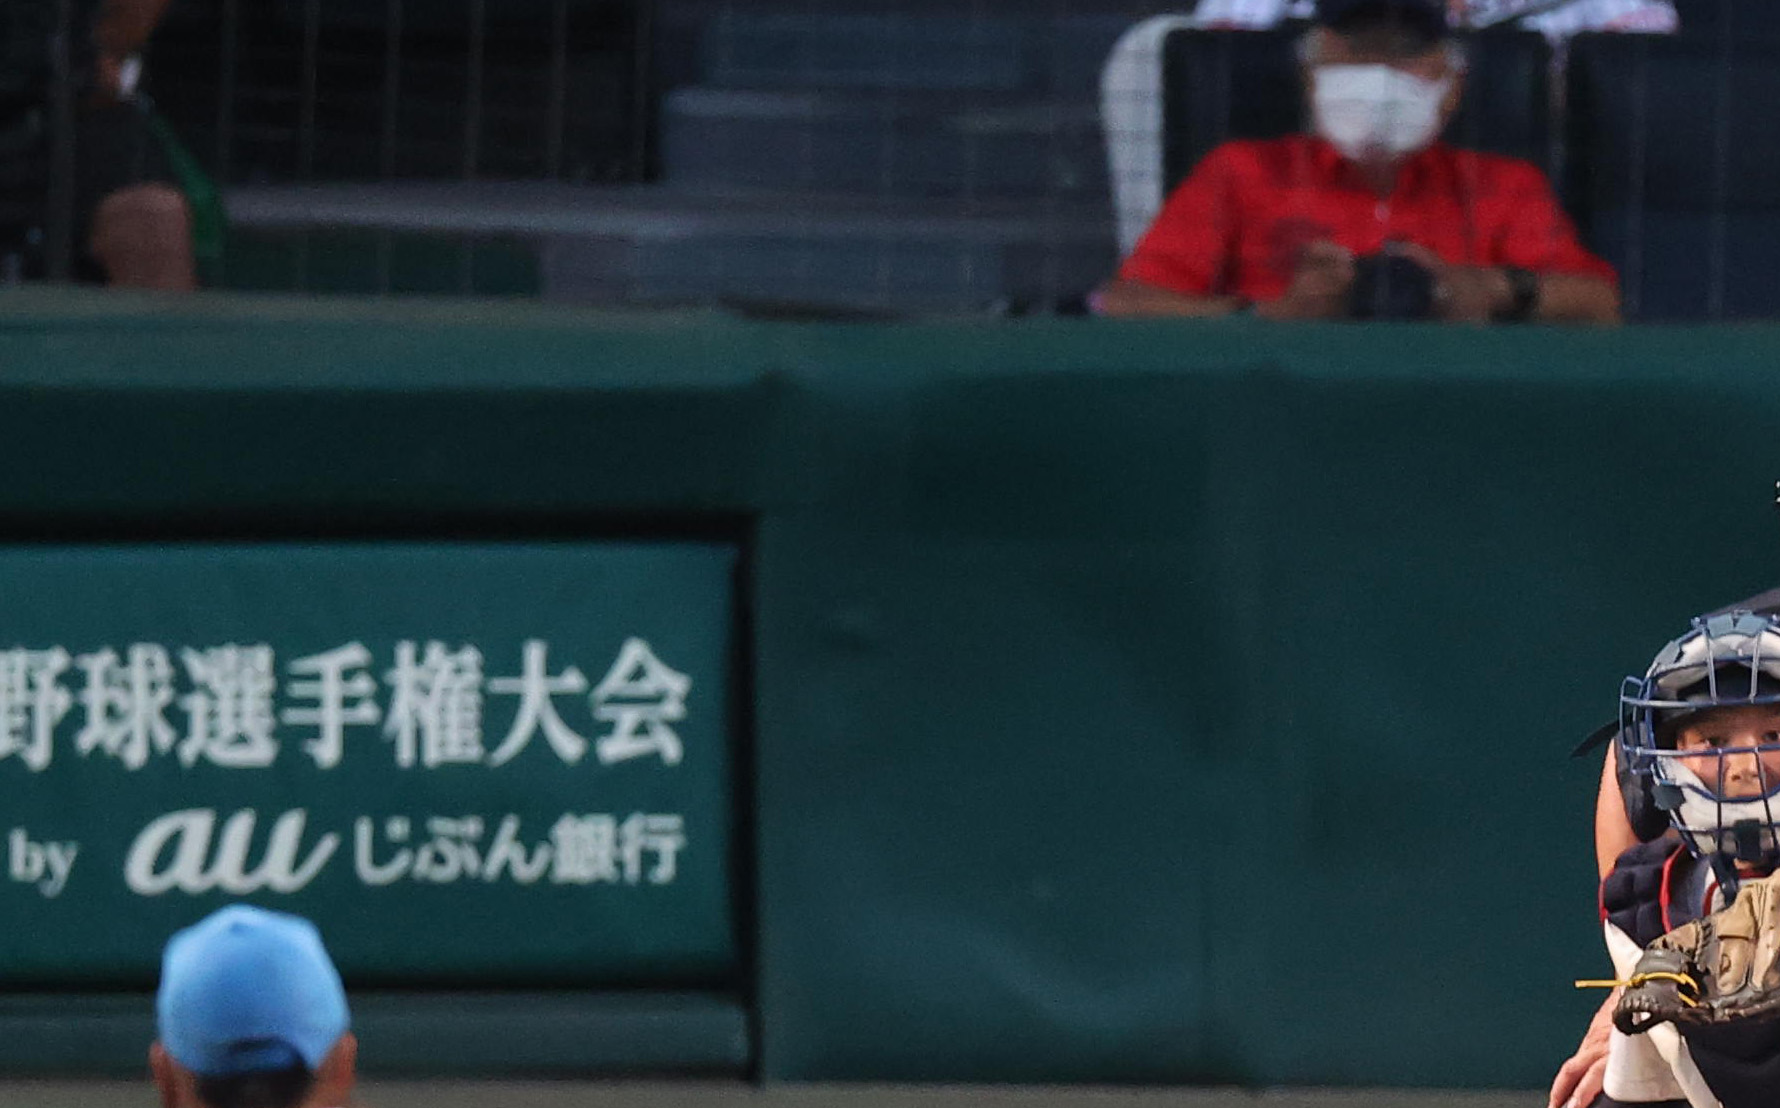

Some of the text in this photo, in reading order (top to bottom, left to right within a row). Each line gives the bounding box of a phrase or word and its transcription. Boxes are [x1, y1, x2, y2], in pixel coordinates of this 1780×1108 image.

[0, 638, 692, 772] 野球選手権大会
[9, 829, 79, 896] by
